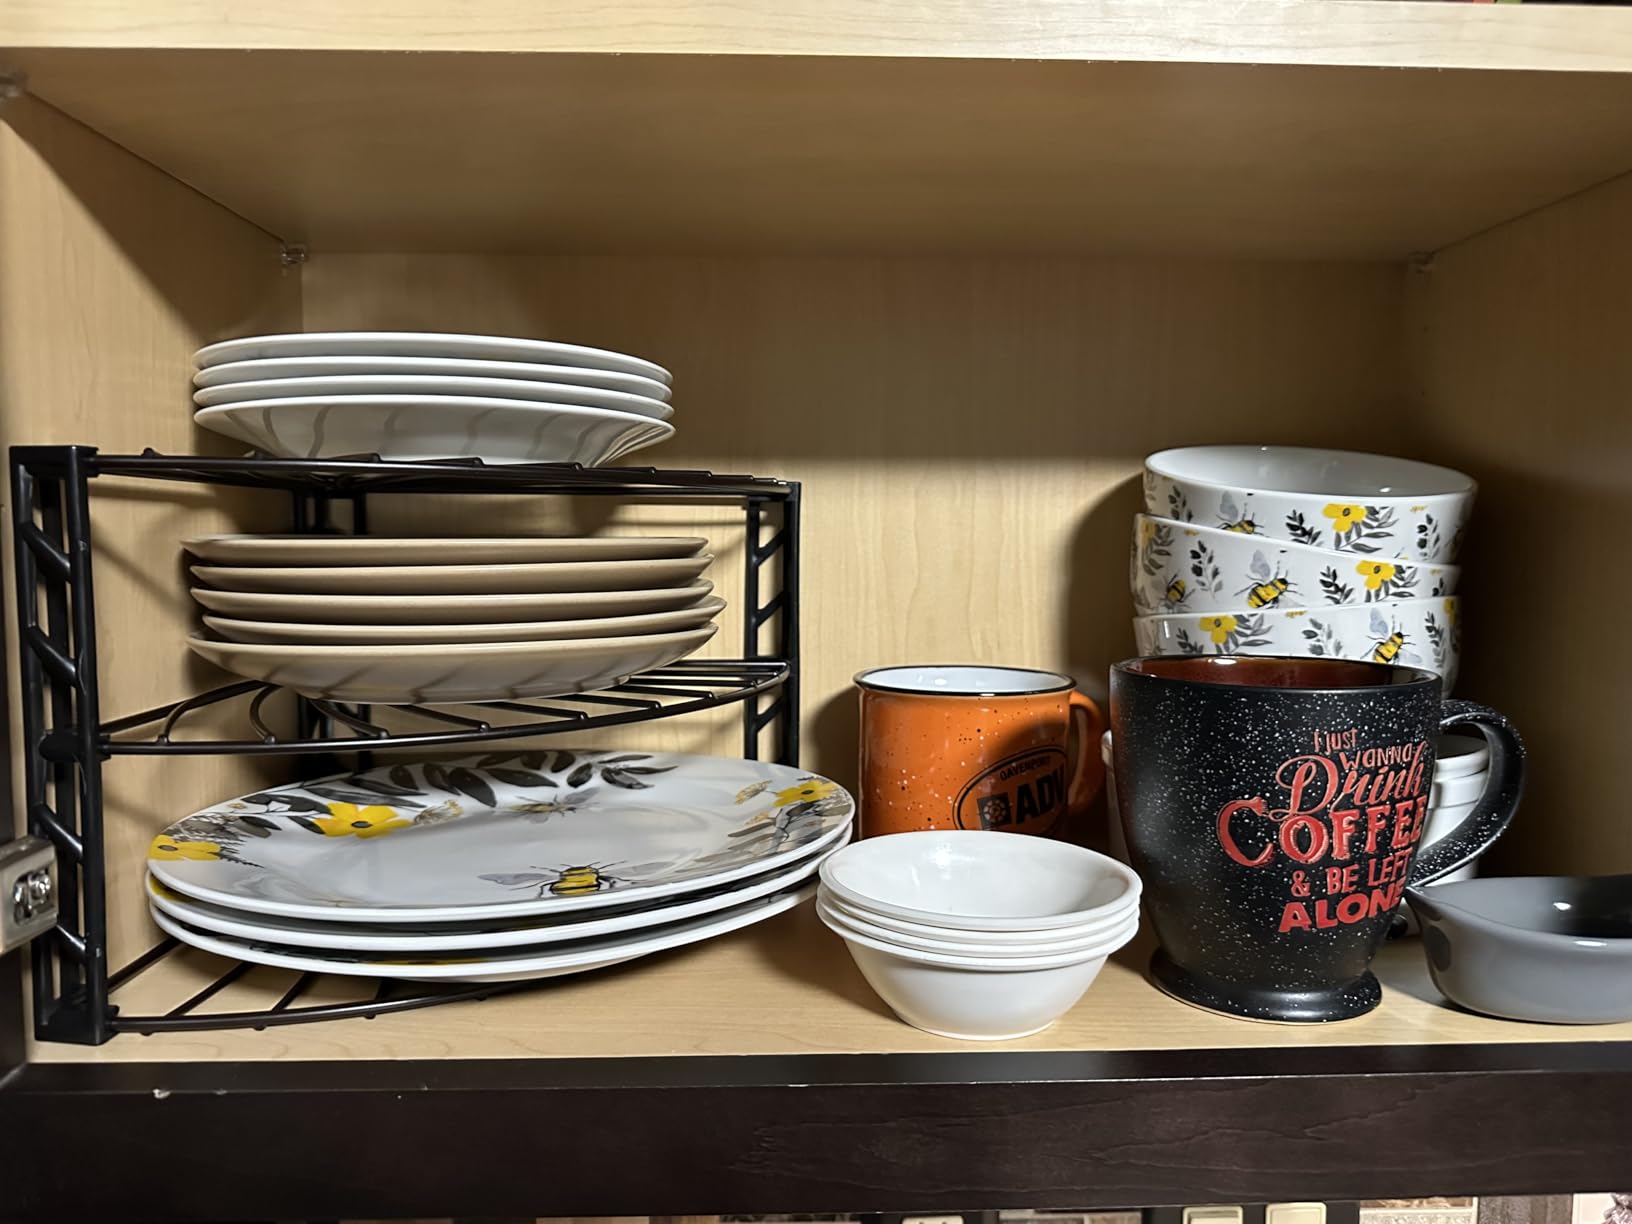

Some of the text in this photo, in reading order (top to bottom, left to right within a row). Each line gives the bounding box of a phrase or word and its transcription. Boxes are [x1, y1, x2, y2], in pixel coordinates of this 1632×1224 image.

[1313, 730, 1320, 752] I
[1269, 741, 1428, 822] Drink
[1216, 795, 1428, 868] COFFEE
[1290, 847, 1414, 897] & BE LEFT
[1278, 876, 1407, 933] ALONE
